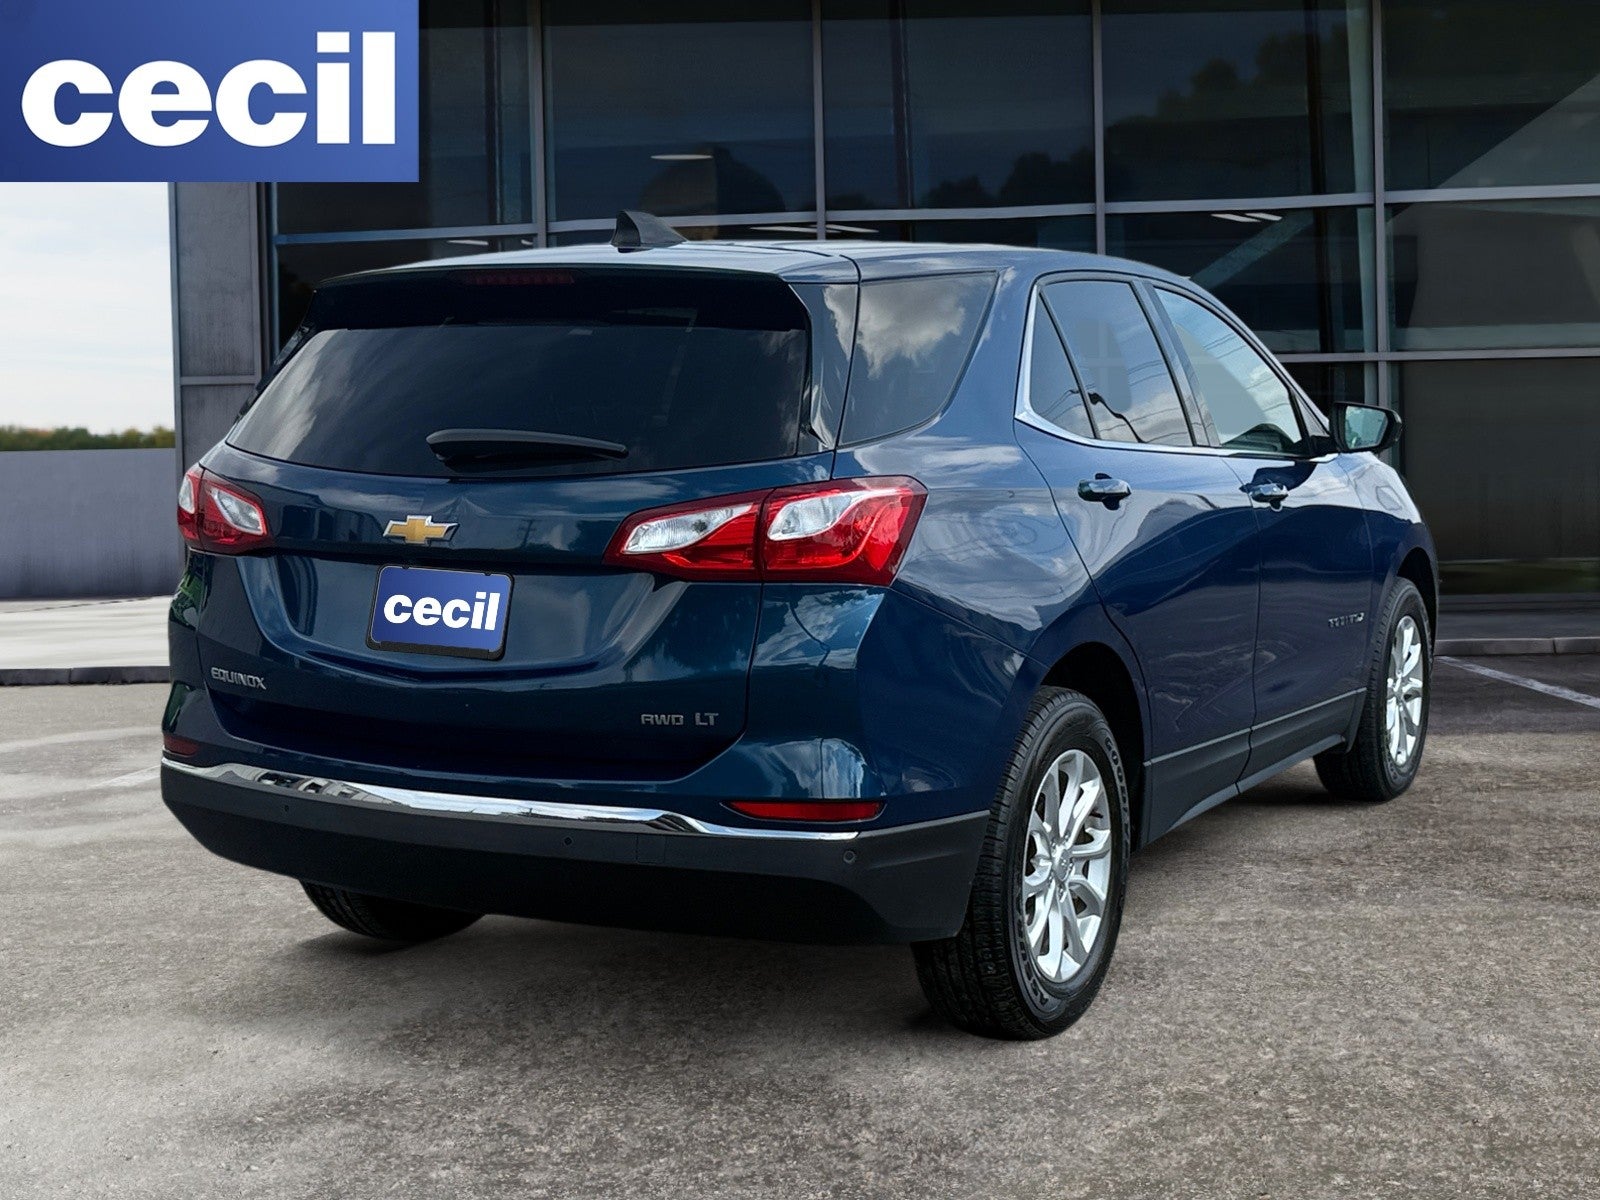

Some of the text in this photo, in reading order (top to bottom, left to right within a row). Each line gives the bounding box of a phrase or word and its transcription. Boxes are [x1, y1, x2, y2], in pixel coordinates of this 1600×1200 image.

[210, 666, 267, 690] EQUINOX
[640, 712, 719, 726] AWD LT
